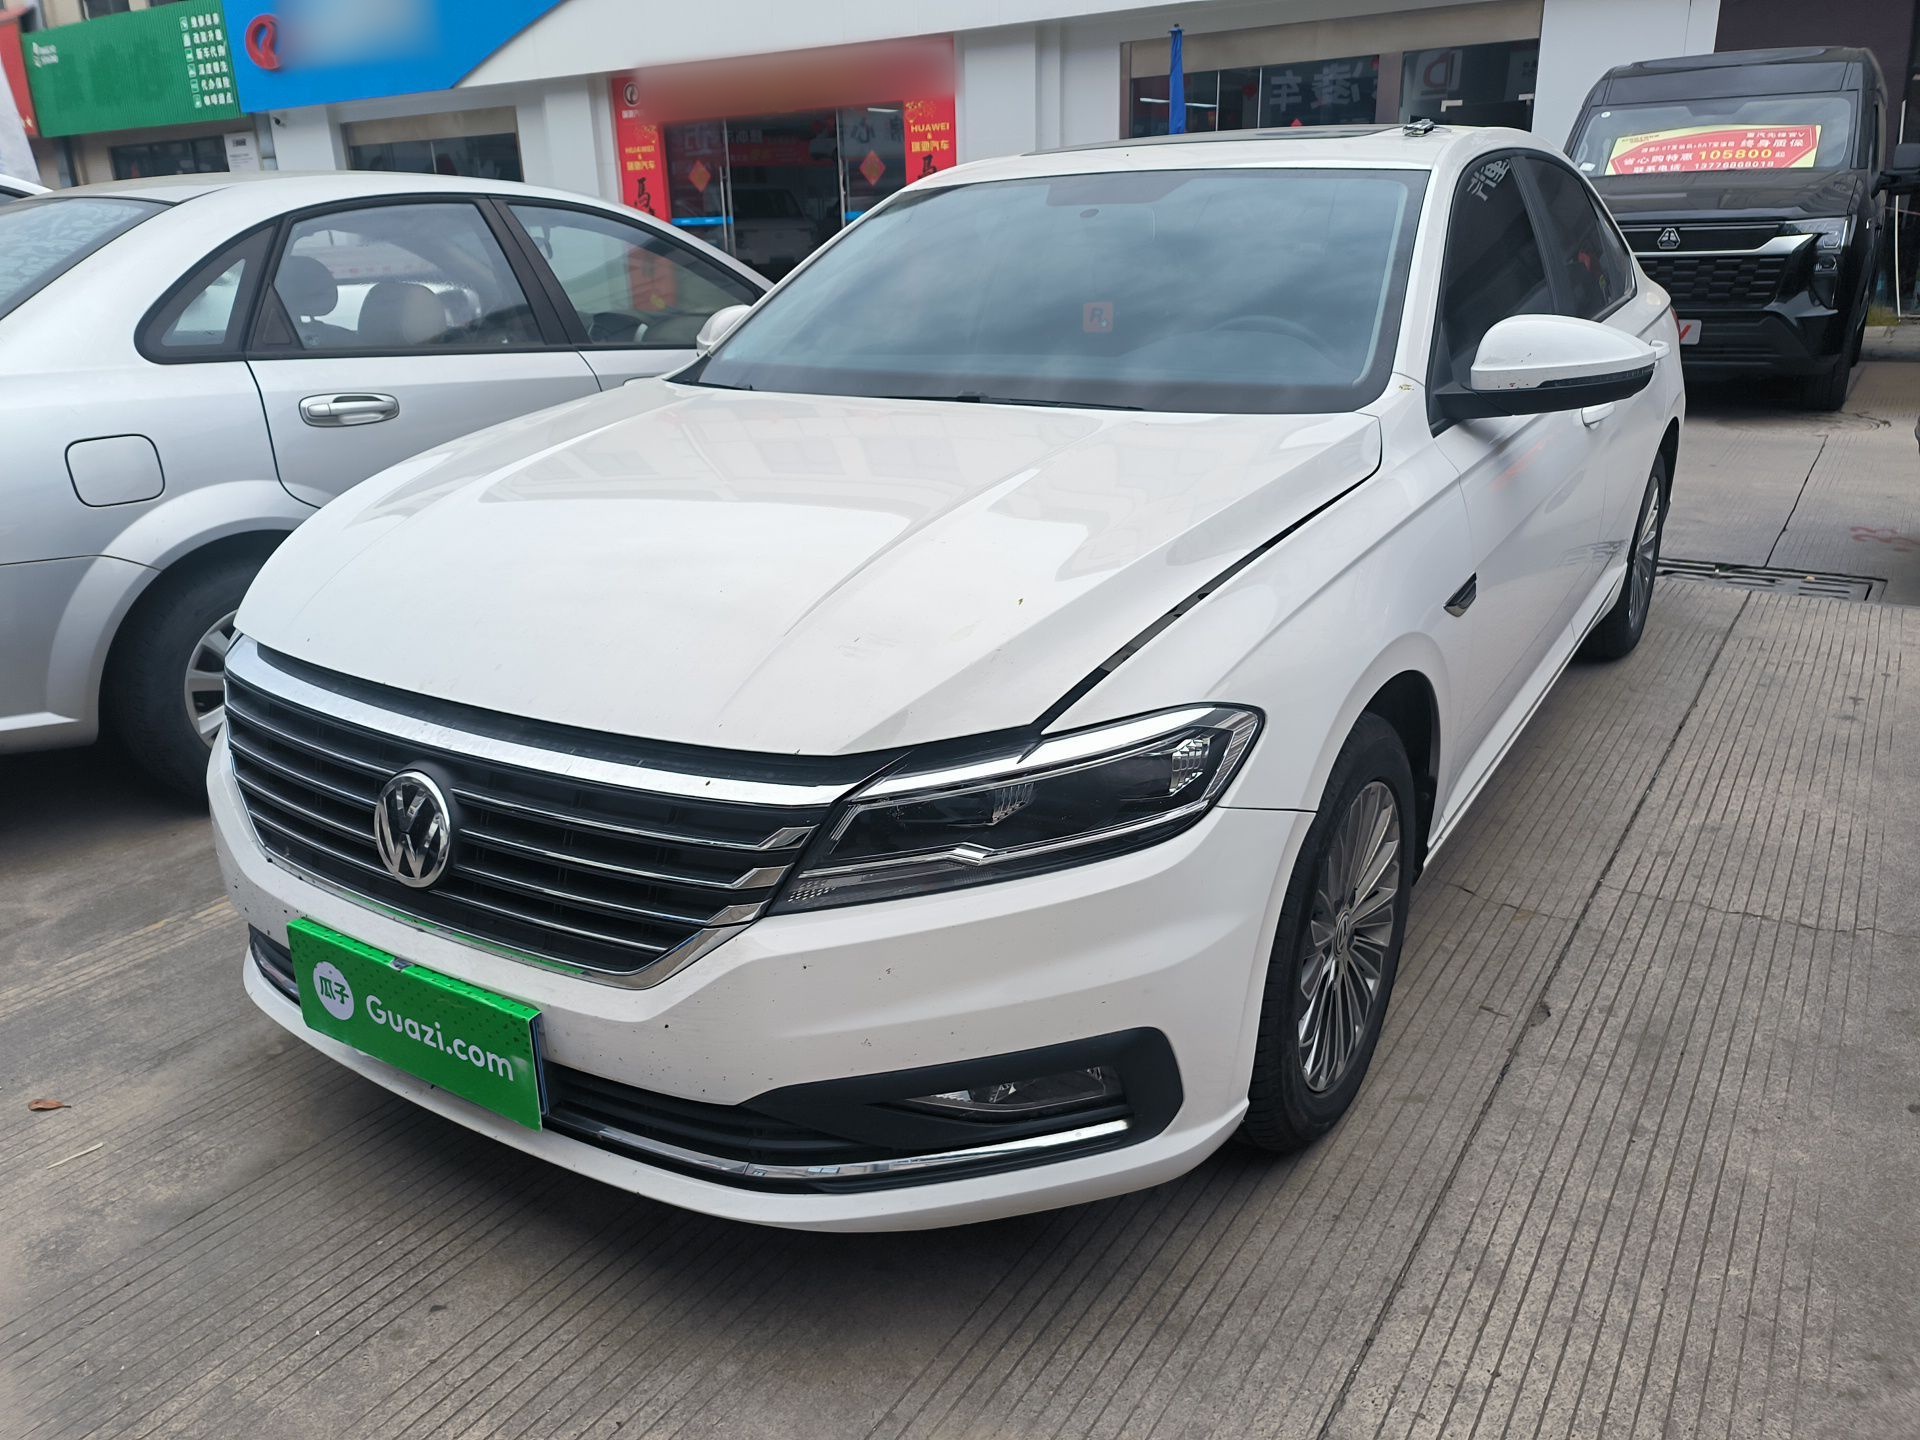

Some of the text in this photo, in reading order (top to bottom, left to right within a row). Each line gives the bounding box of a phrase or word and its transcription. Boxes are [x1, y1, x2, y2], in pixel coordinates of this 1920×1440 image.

[910, 122, 950, 133] HUAWEI
[1740, 138, 1804, 149] 终身质保
[1699, 148, 1773, 161] 105800
[318, 976, 350, 1006] 瓜子
[365, 994, 514, 1082] Guazi.com
